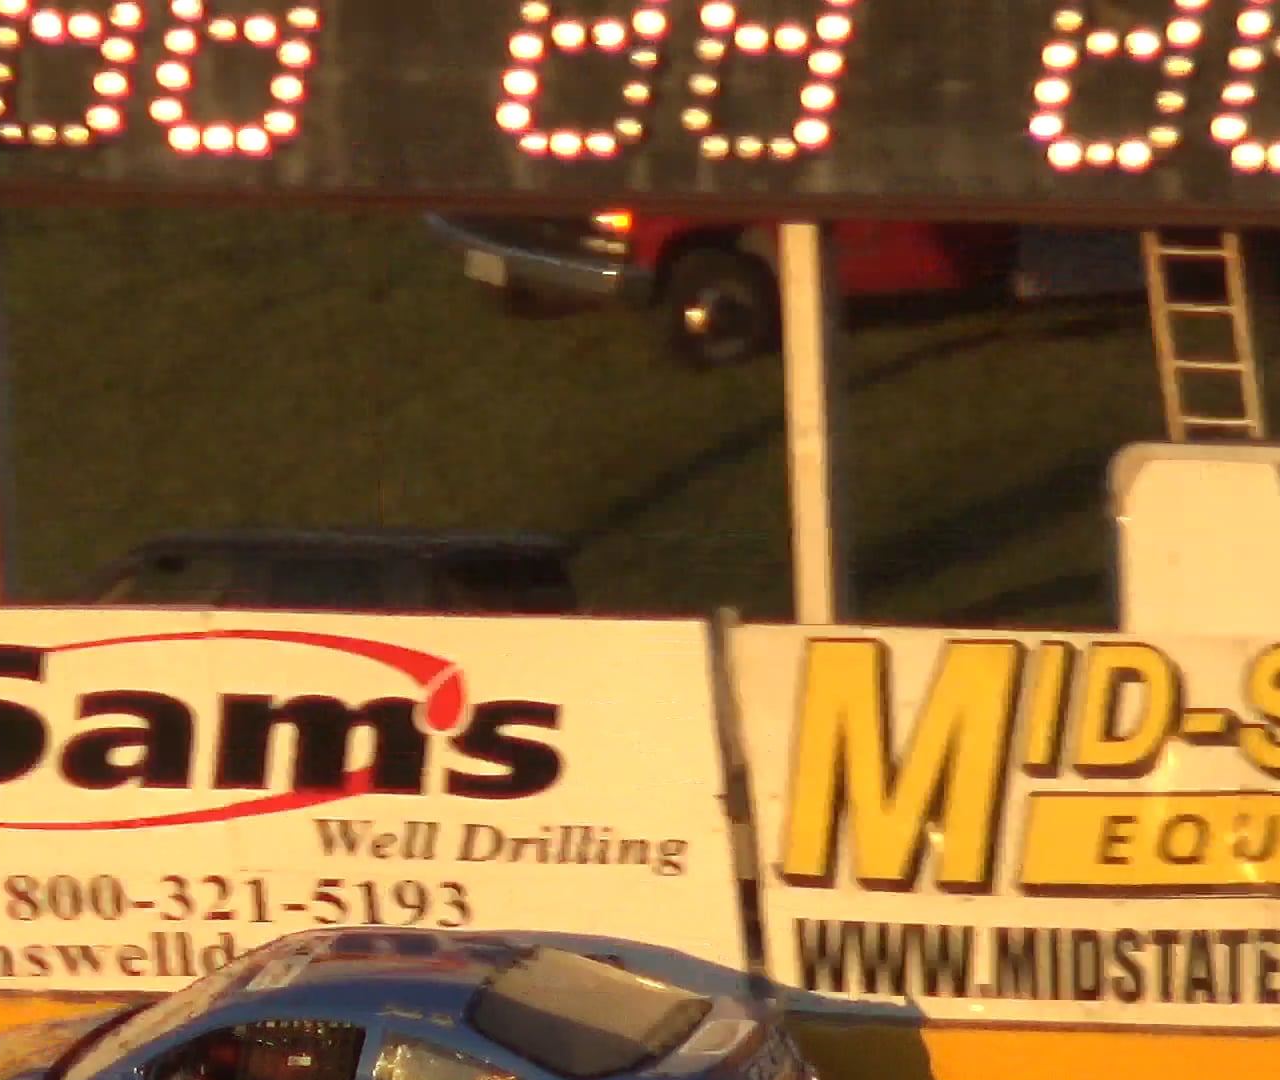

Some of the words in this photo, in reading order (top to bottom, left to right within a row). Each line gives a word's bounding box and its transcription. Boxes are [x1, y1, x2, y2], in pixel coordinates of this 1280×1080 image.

[311, 816, 437, 864] Well
[455, 822, 689, 877] Drilling
[2, 872, 474, 928] 800-321-5193
